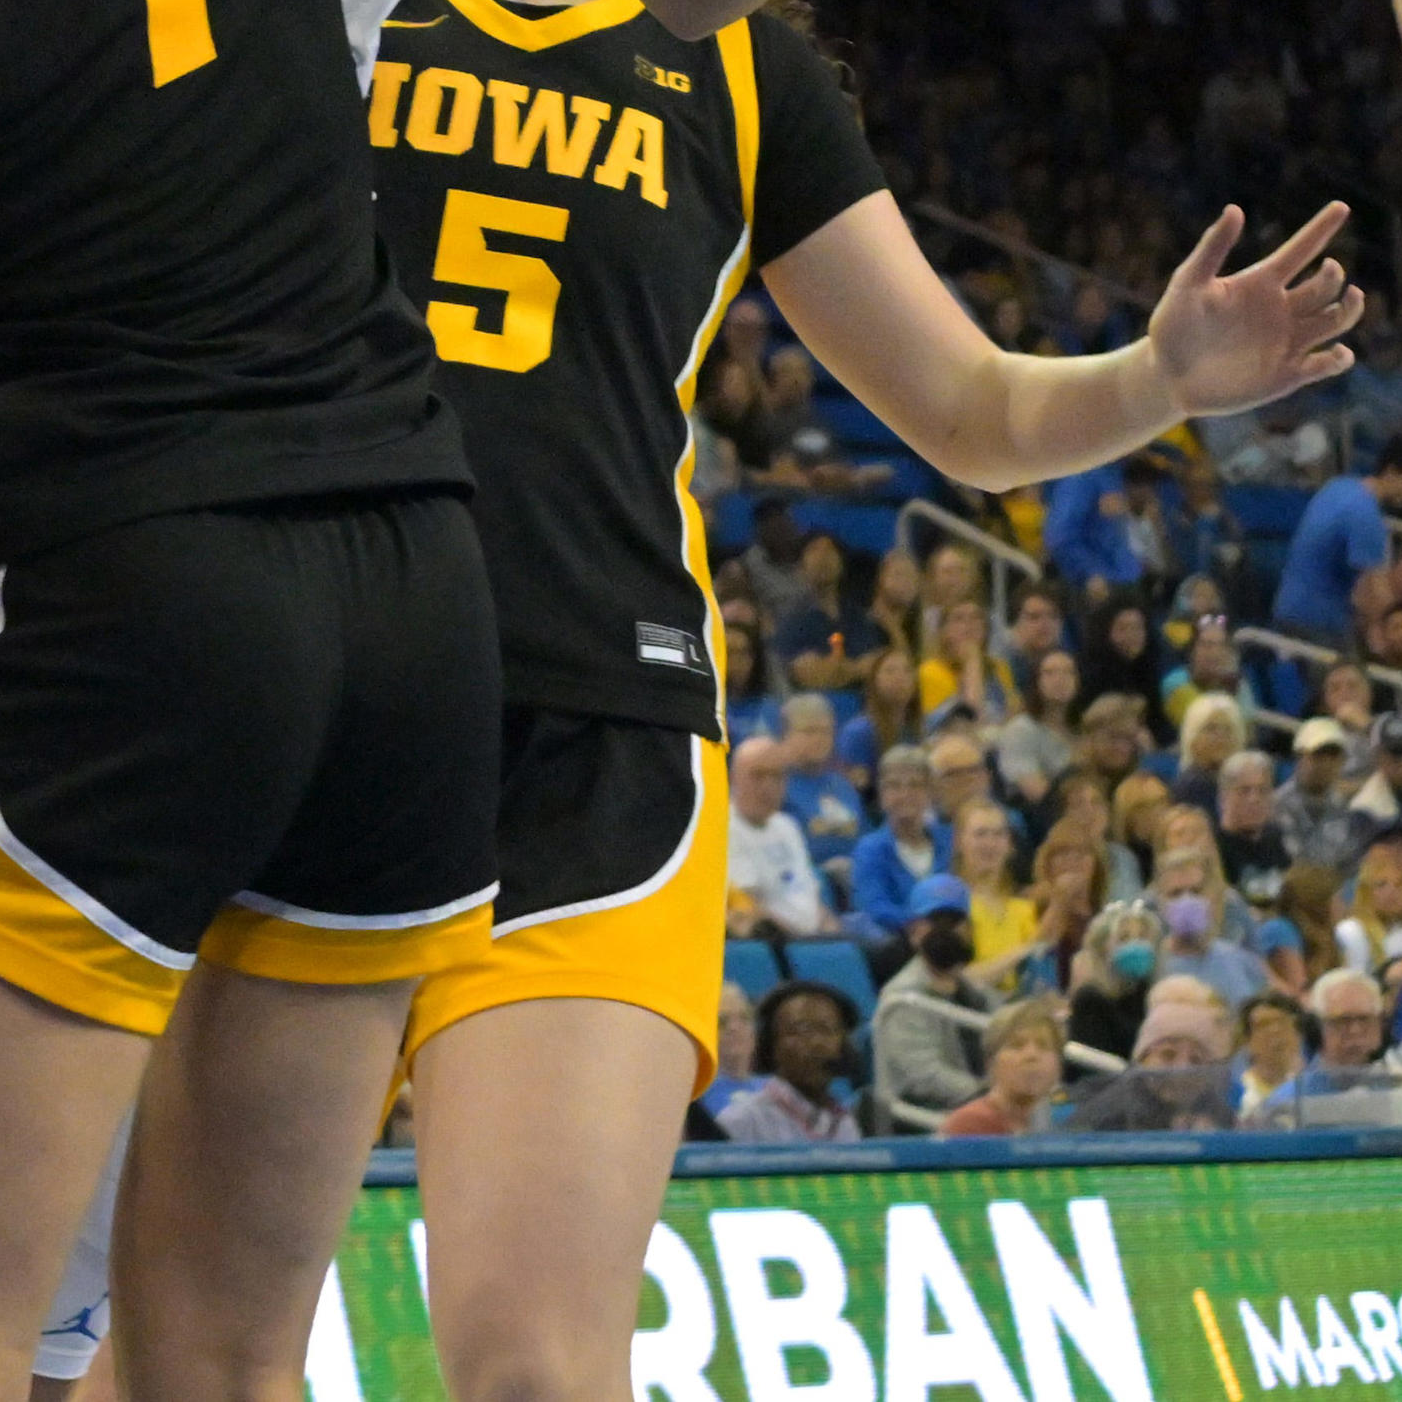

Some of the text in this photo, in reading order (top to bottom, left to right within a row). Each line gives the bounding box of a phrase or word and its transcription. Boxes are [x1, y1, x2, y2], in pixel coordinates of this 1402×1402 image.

[367, 60, 669, 210] IOWA
[426, 188, 570, 374] 5
[409, 1196, 1155, 1402] RBAN
